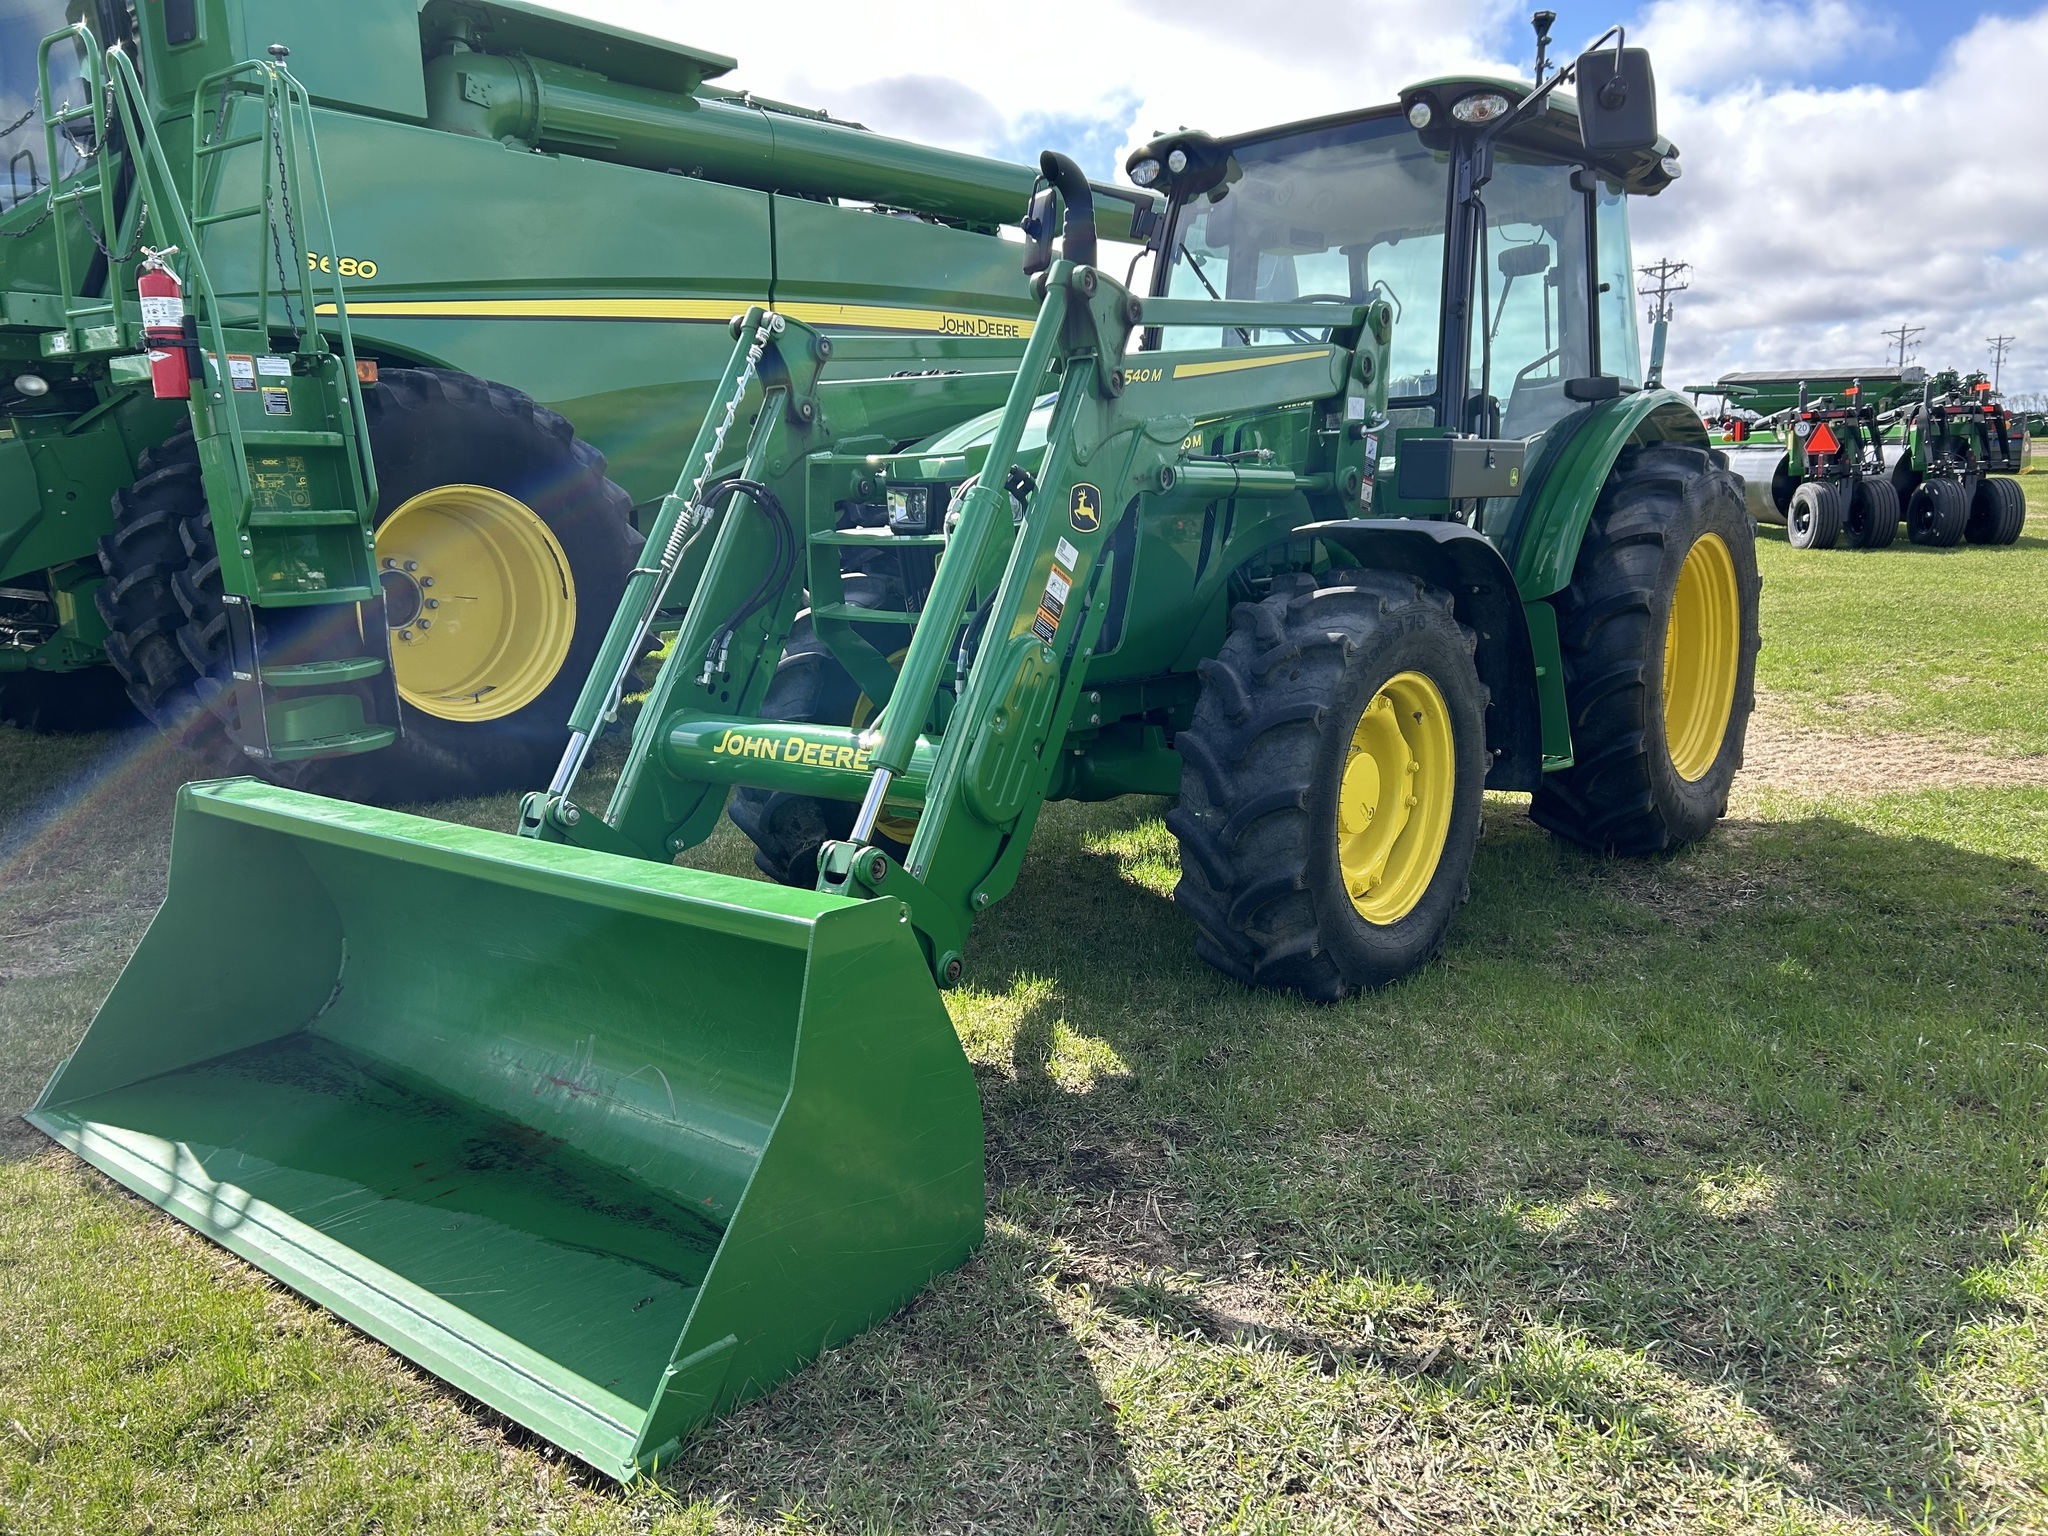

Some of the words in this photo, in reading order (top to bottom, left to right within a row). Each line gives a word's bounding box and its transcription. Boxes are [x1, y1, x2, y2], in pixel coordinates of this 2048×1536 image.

[938, 315, 975, 335] JOHN
[977, 318, 1020, 338] DEERE
[1797, 423, 1808, 432] 20
[713, 729, 781, 760] JOHN
[783, 736, 872, 771] DEERE
